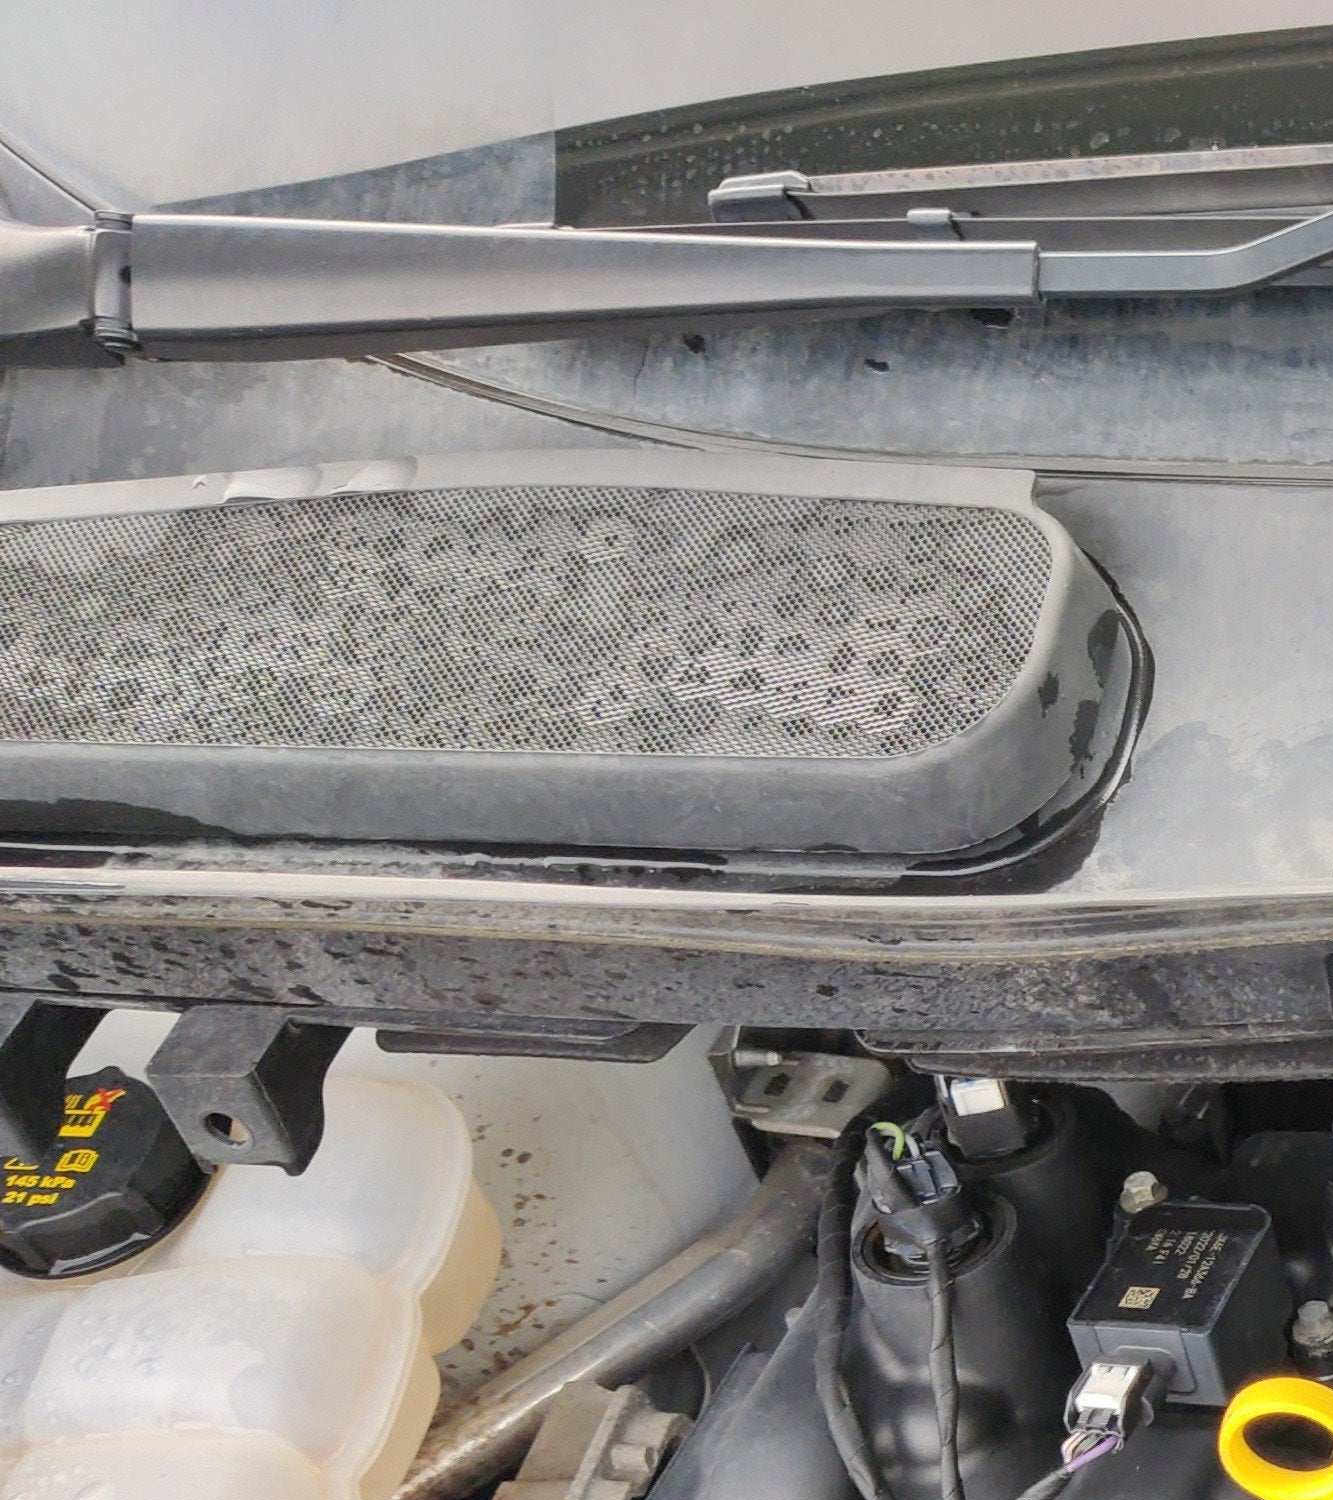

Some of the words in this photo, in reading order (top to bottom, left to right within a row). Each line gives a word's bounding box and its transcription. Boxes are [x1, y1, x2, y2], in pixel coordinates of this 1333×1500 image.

[6, 1174, 40, 1188] 145
[39, 1174, 77, 1189] kPa
[2, 1191, 28, 1204] 21
[26, 1192, 60, 1207] psi
